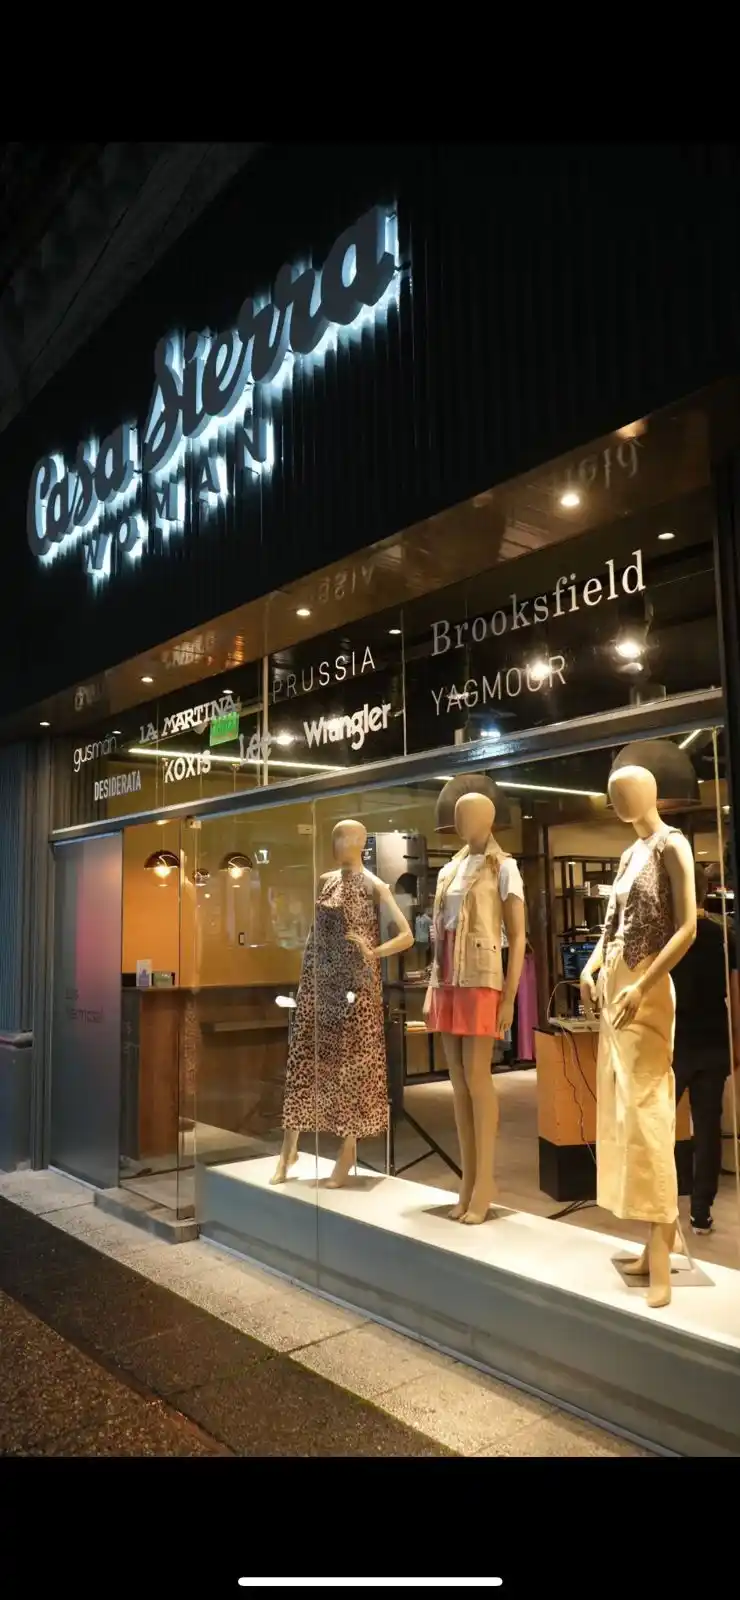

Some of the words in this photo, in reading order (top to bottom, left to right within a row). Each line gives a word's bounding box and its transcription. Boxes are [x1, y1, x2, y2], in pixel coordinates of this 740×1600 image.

[27, 422, 139, 556] Casa
[144, 203, 397, 472] Sierra
[83, 407, 273, 572] WOMAN
[430, 549, 646, 656] Brooksfield
[272, 645, 376, 703] PRUSSIA
[431, 655, 566, 716] YAGMOUR
[139, 724, 158, 744] LA
[161, 695, 237, 737] MARTINA
[238, 729, 272, 766] Lee
[303, 702, 391, 750] Wrangler
[94, 771, 141, 801] DESIDERATA
